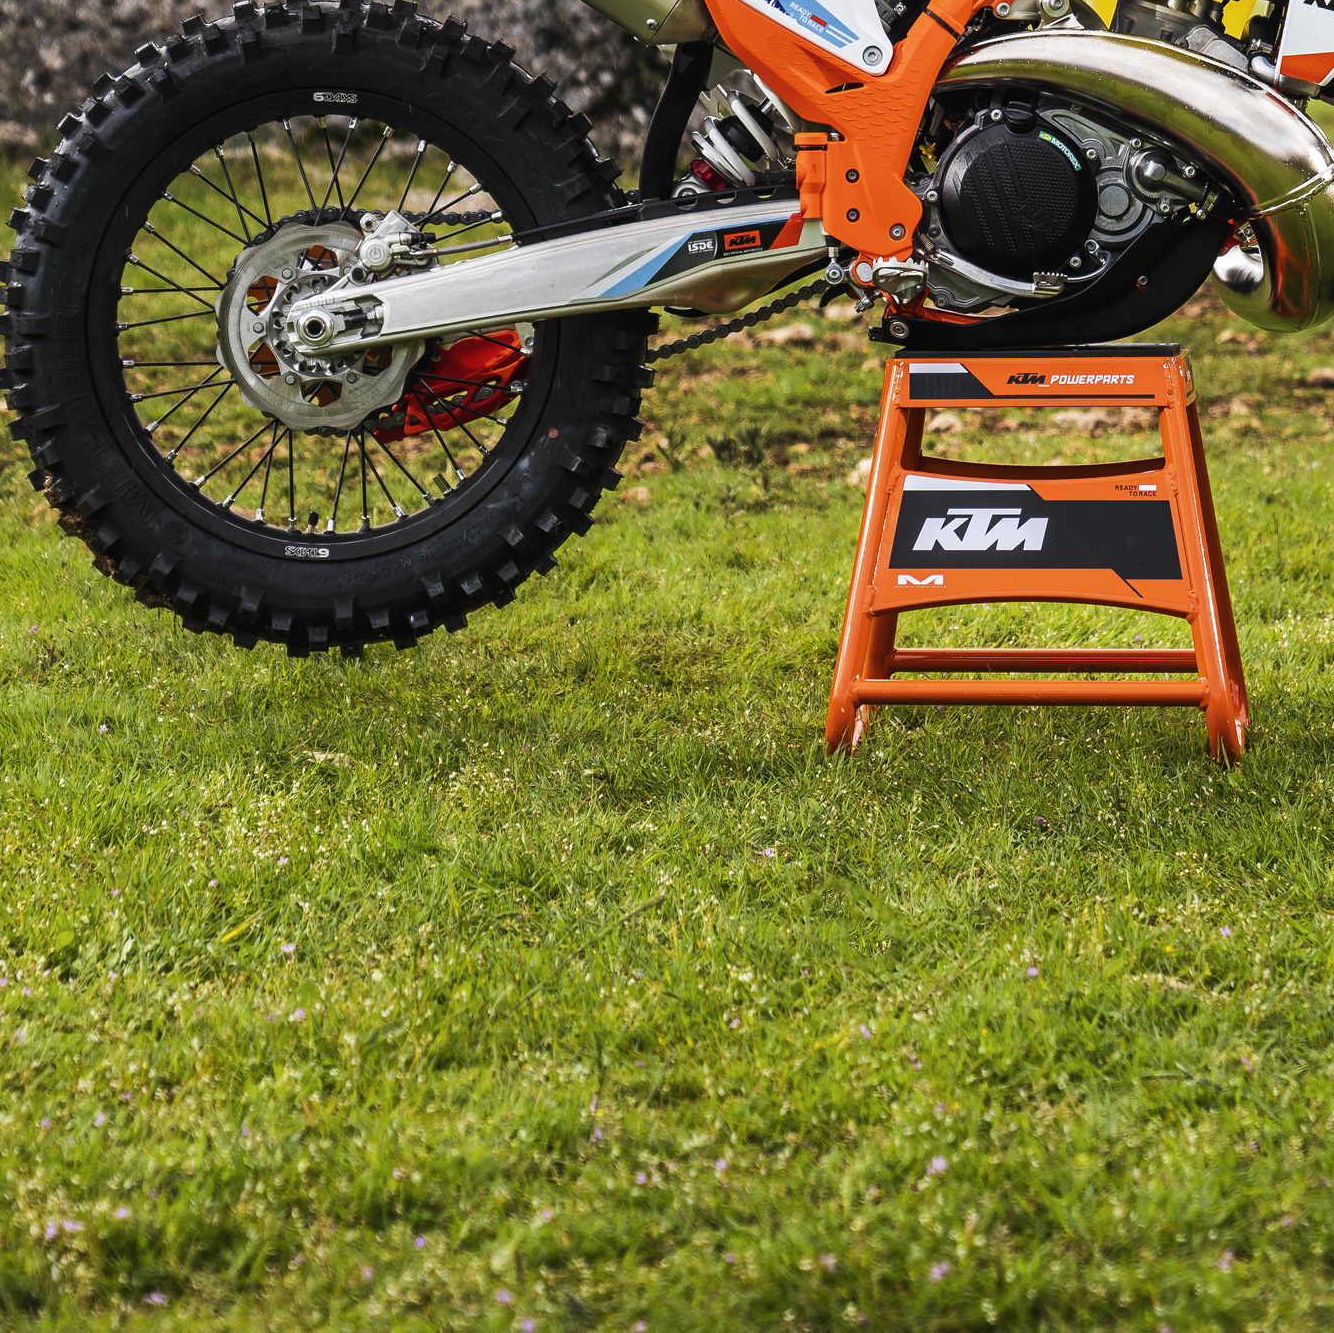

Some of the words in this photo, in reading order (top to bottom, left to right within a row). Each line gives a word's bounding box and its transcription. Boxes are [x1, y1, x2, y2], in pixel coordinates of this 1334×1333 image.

[790, 1, 811, 17] READY
[807, 19, 825, 34] RACE
[1051, 137, 1081, 168] MOTOREX
[728, 234, 757, 247] KTM
[1007, 372, 1047, 385] KTM
[912, 508, 1049, 551] KTM
